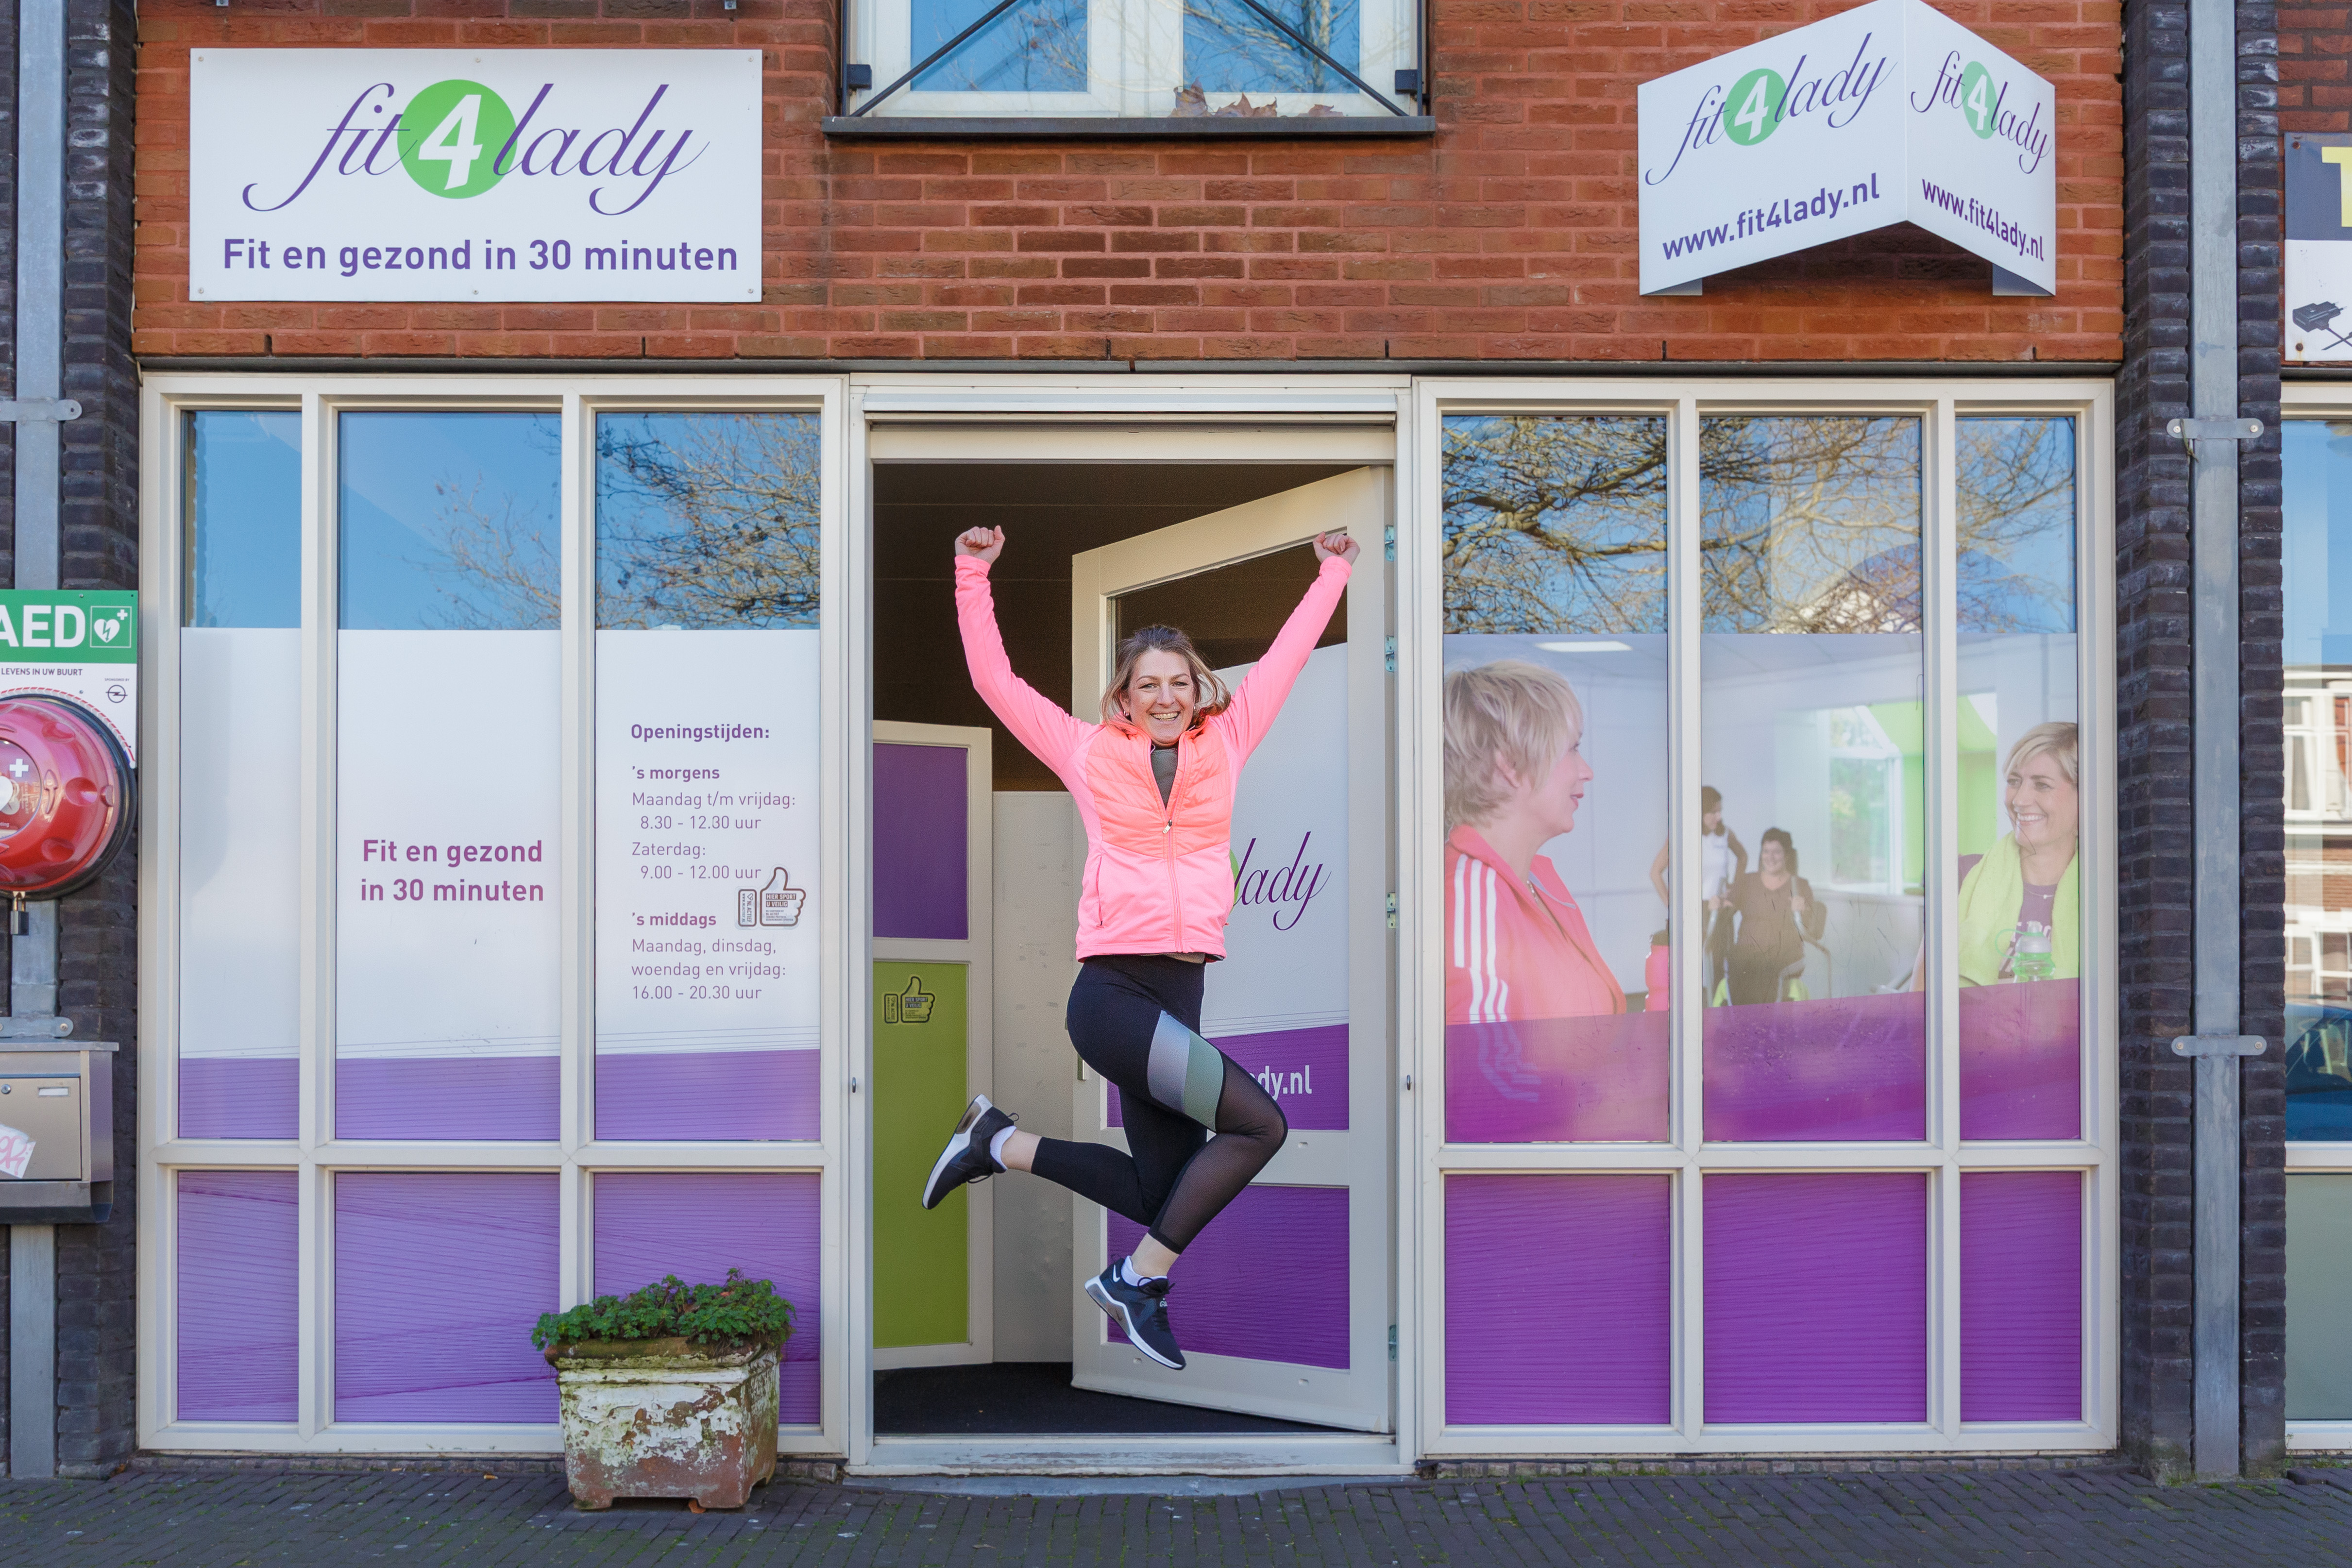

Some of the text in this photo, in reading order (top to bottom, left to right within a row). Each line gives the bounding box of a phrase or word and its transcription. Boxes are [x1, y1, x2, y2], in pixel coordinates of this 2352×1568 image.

[1644, 32, 1898, 185] fit4lady
[1910, 50, 2052, 174] fit4lady
[241, 82, 711, 216] fit4lady
[1662, 172, 1880, 260] www.fit4lady.nl
[1921, 178, 2044, 261] www.fit4lady.nl
[224, 238, 737, 277] Fit en gezond in 30 minuten
[0, 604, 86, 648] AED
[631, 724, 769, 742] Openingstijden:
[650, 769, 720, 782] morgens
[633, 791, 795, 809] Maandag t/m vrijdag:
[641, 815, 672, 829] 8.30
[690, 815, 729, 829] 12.30
[735, 819, 761, 829] uur
[363, 839, 542, 868] Fit en gezond
[632, 842, 705, 860] Zaterdag:
[641, 865, 672, 879] 9.00
[690, 865, 729, 879] 12.00
[735, 869, 761, 879] uur
[361, 878, 543, 901] in 30 minuten
[650, 912, 716, 929] middags
[633, 938, 776, 956] Maandag, dinsdag,
[631, 961, 785, 979] woendag en vrijdag:
[633, 985, 672, 999] 16.00
[690, 985, 729, 999] 20.30
[736, 989, 762, 999] uur
